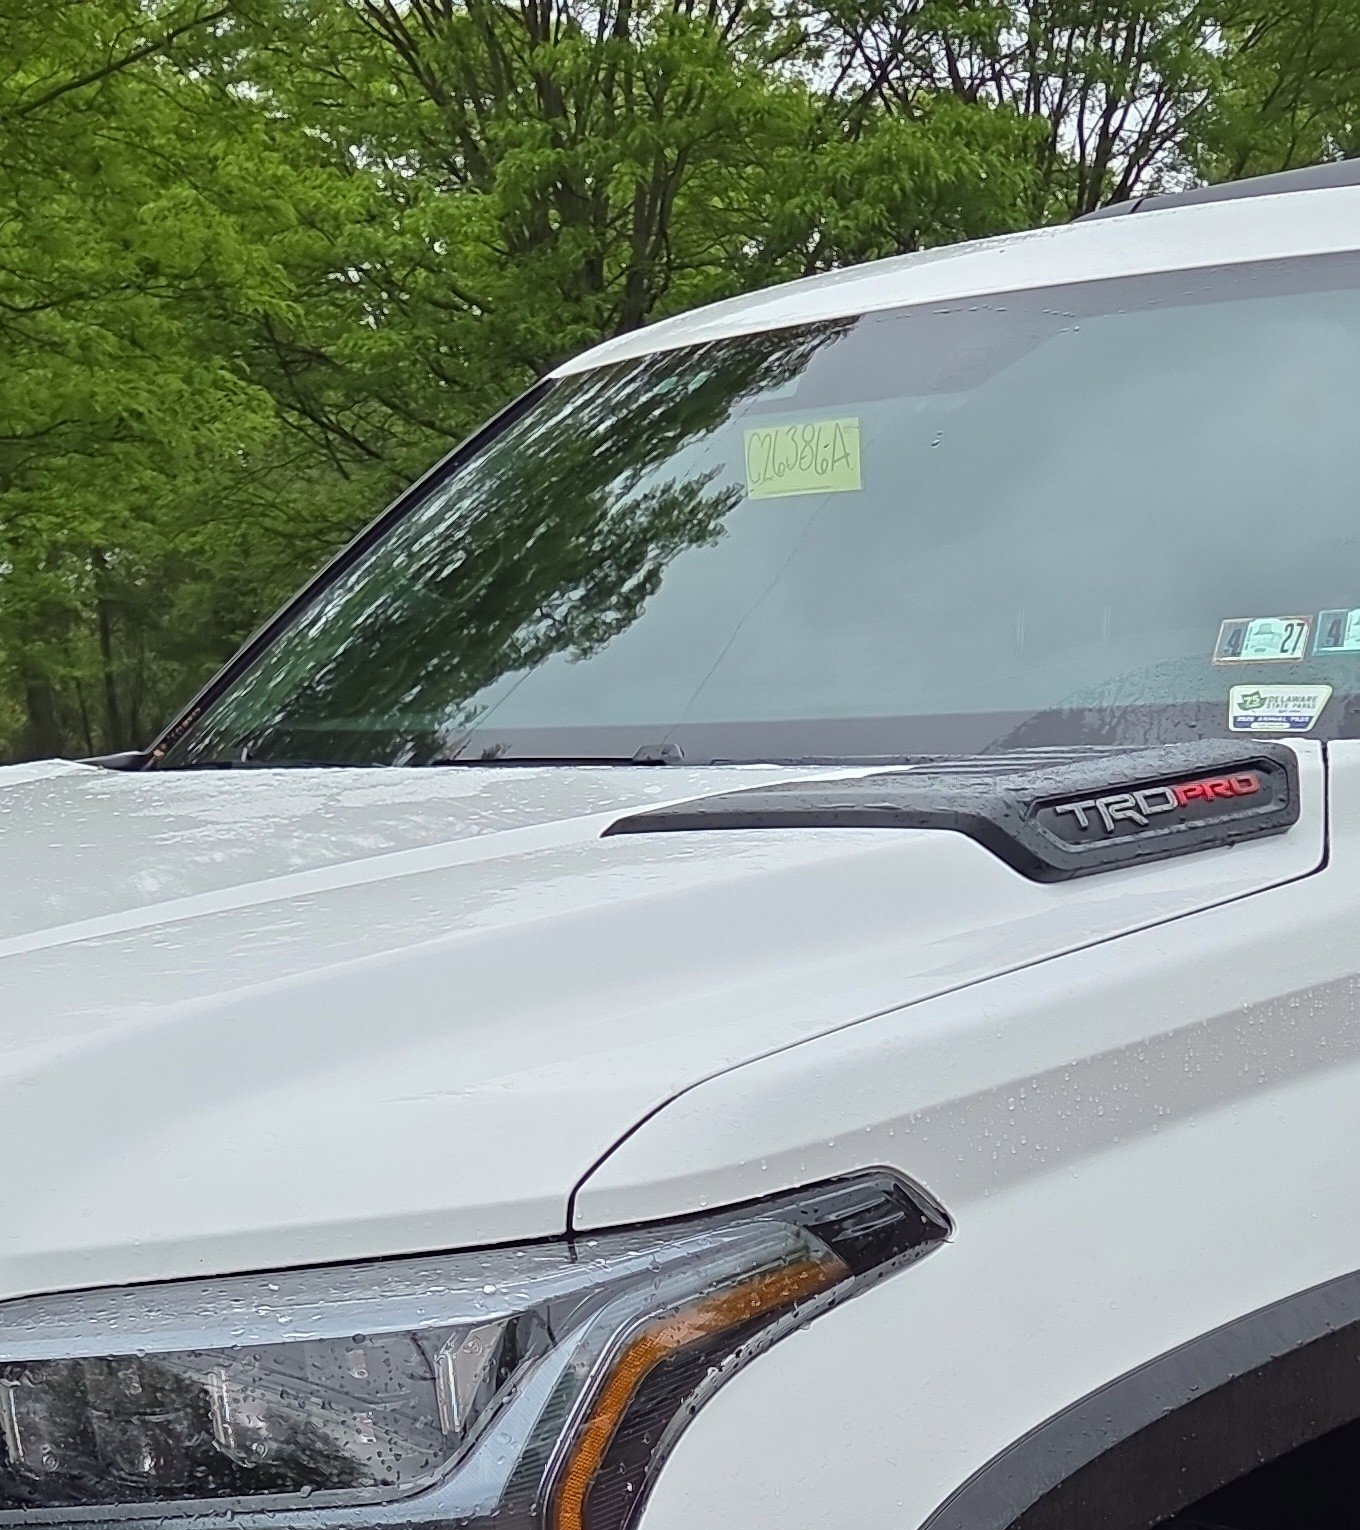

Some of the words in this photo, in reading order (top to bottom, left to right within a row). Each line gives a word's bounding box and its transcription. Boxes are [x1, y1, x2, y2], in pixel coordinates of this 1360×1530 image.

[1279, 622, 1306, 656] 27
[1266, 702, 1289, 710] STATE
[1292, 702, 1317, 710] PARKS
[1268, 695, 1318, 703] DELAWARE
[1055, 786, 1179, 833] TRD
[1172, 772, 1261, 808] PRO
